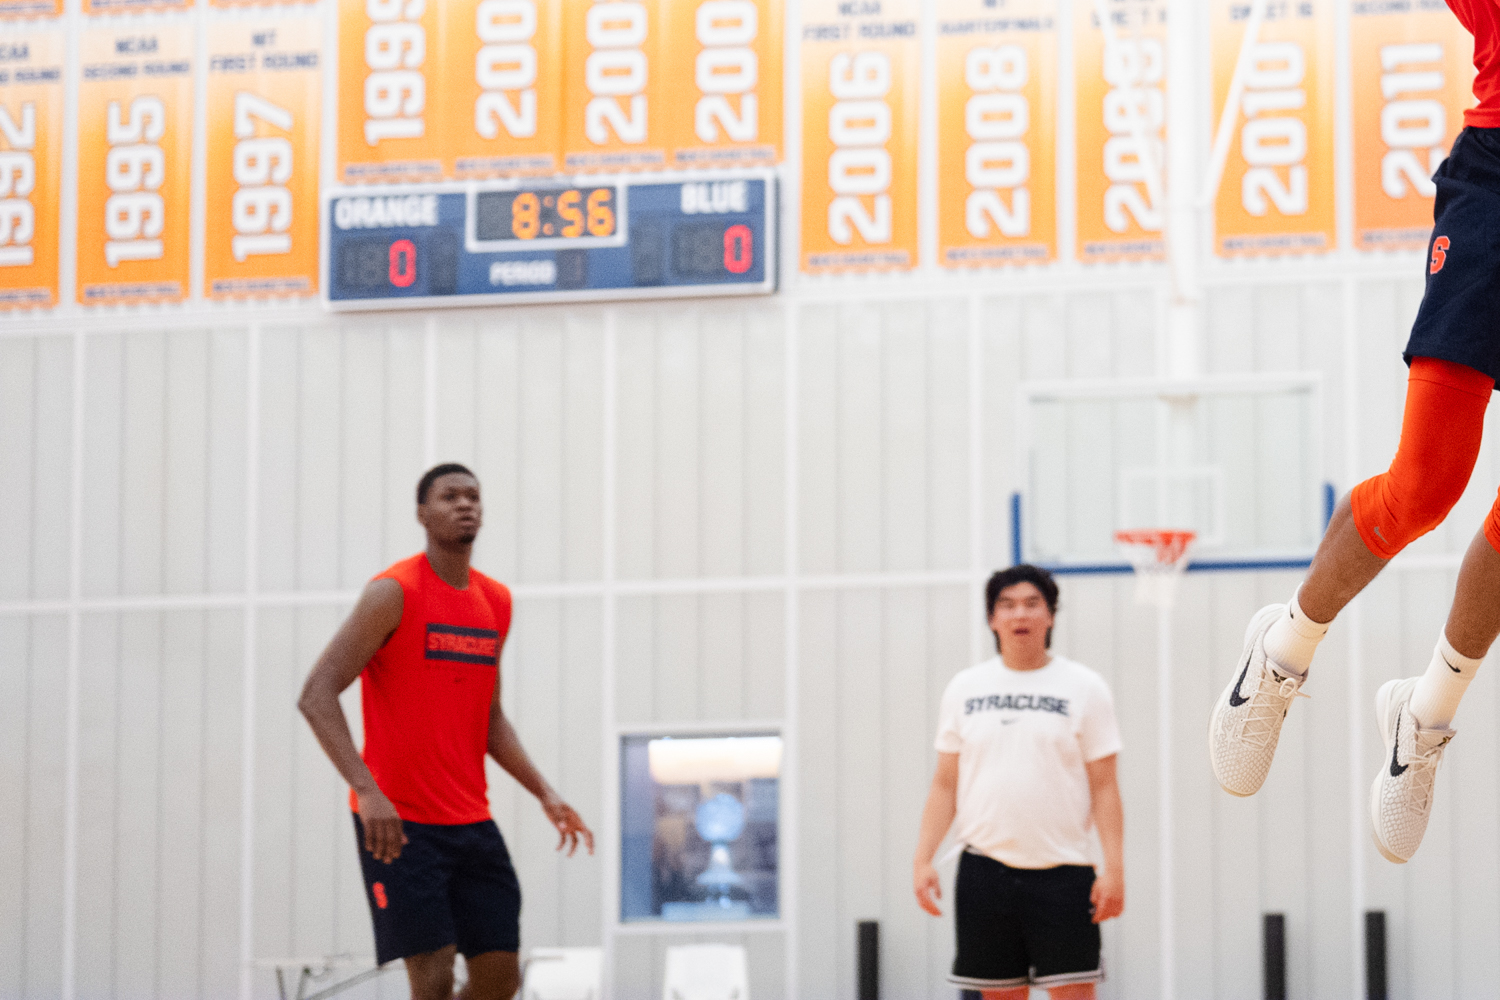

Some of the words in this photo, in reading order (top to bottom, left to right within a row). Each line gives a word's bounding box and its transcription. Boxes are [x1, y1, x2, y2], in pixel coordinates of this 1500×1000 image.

[828, 52, 892, 244] 2006
[965, 45, 1029, 239] 2008
[1242, 42, 1308, 216] 2010
[1381, 43, 1446, 198] 2011
[105, 96, 165, 268] 1995
[232, 92, 292, 262] 1997
[335, 194, 439, 229] ORANGE
[512, 189, 615, 239] 8:56
[681, 182, 747, 214] BLUE
[490, 260, 556, 285] PERIOD
[1430, 236, 1451, 274] S
[965, 694, 1069, 717] SYRACUSE
